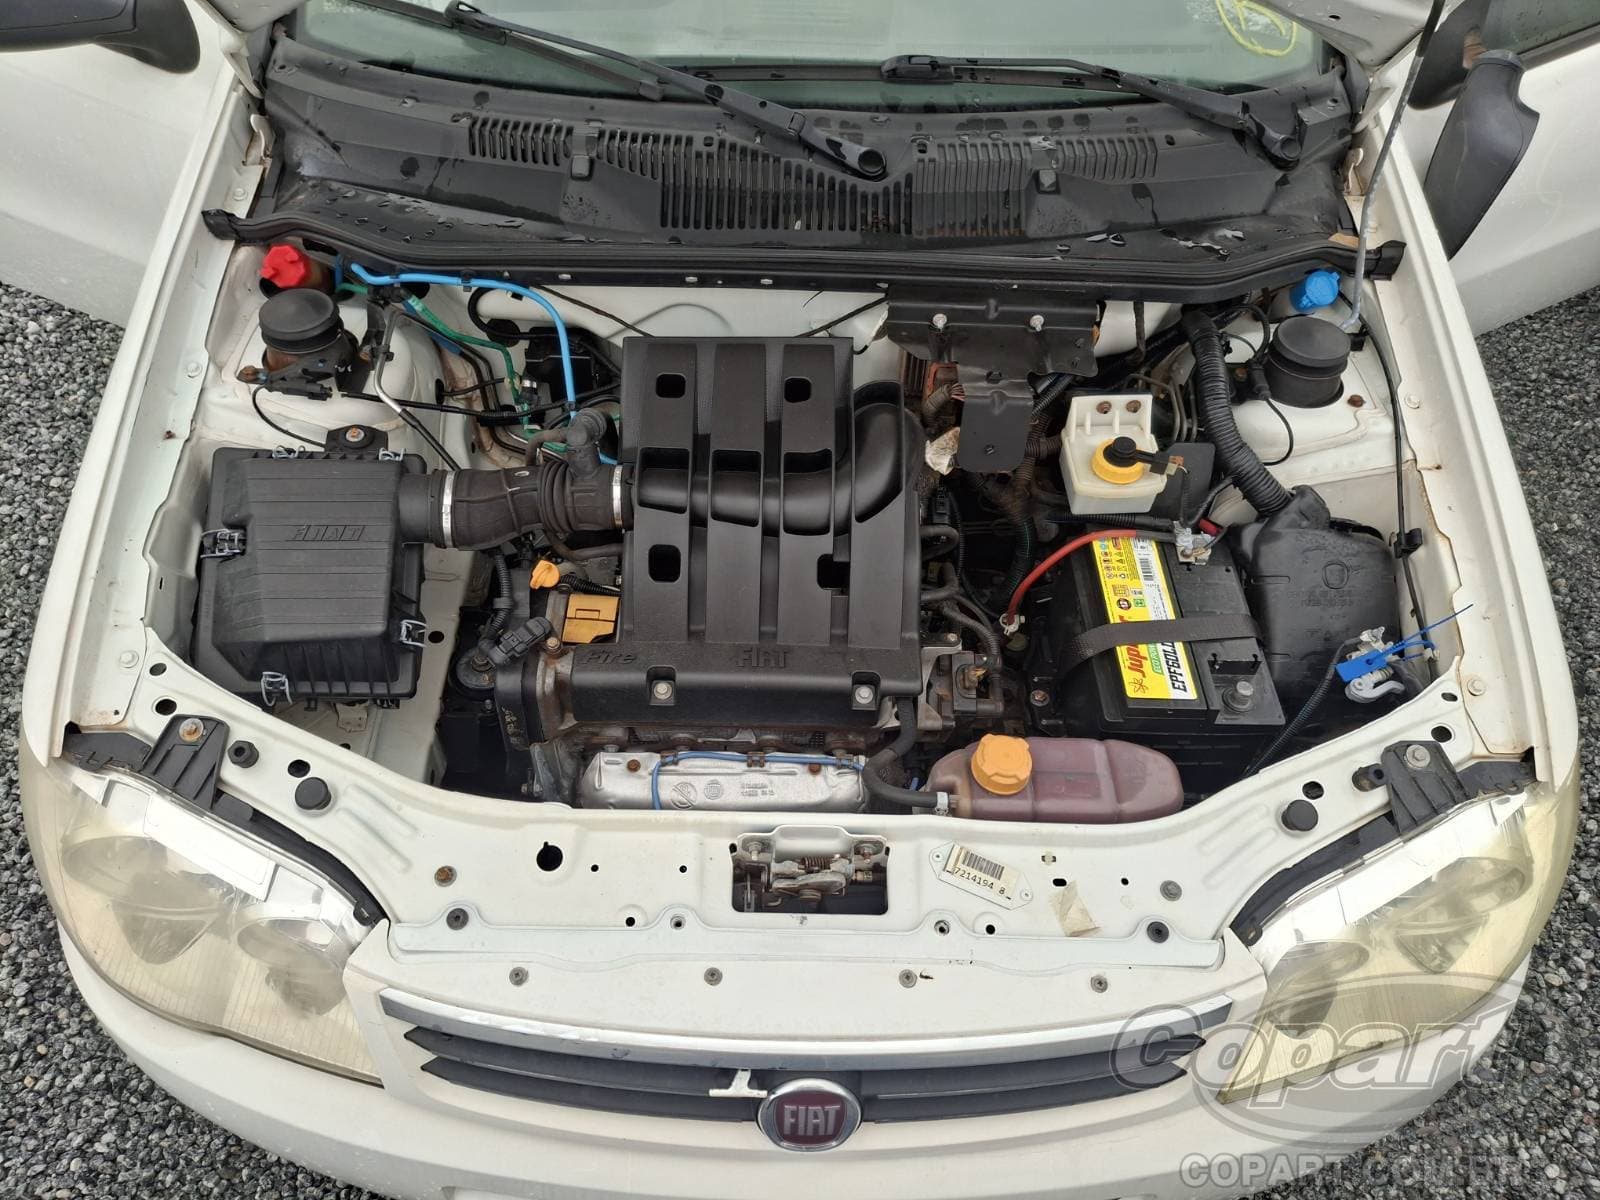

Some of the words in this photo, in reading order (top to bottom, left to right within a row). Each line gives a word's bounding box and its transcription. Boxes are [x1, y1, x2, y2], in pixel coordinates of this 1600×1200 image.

[289, 525, 365, 541] FIAT
[736, 647, 789, 668] FIAT
[953, 866, 995, 890] 7214194
[783, 1105, 841, 1136] FIAT
